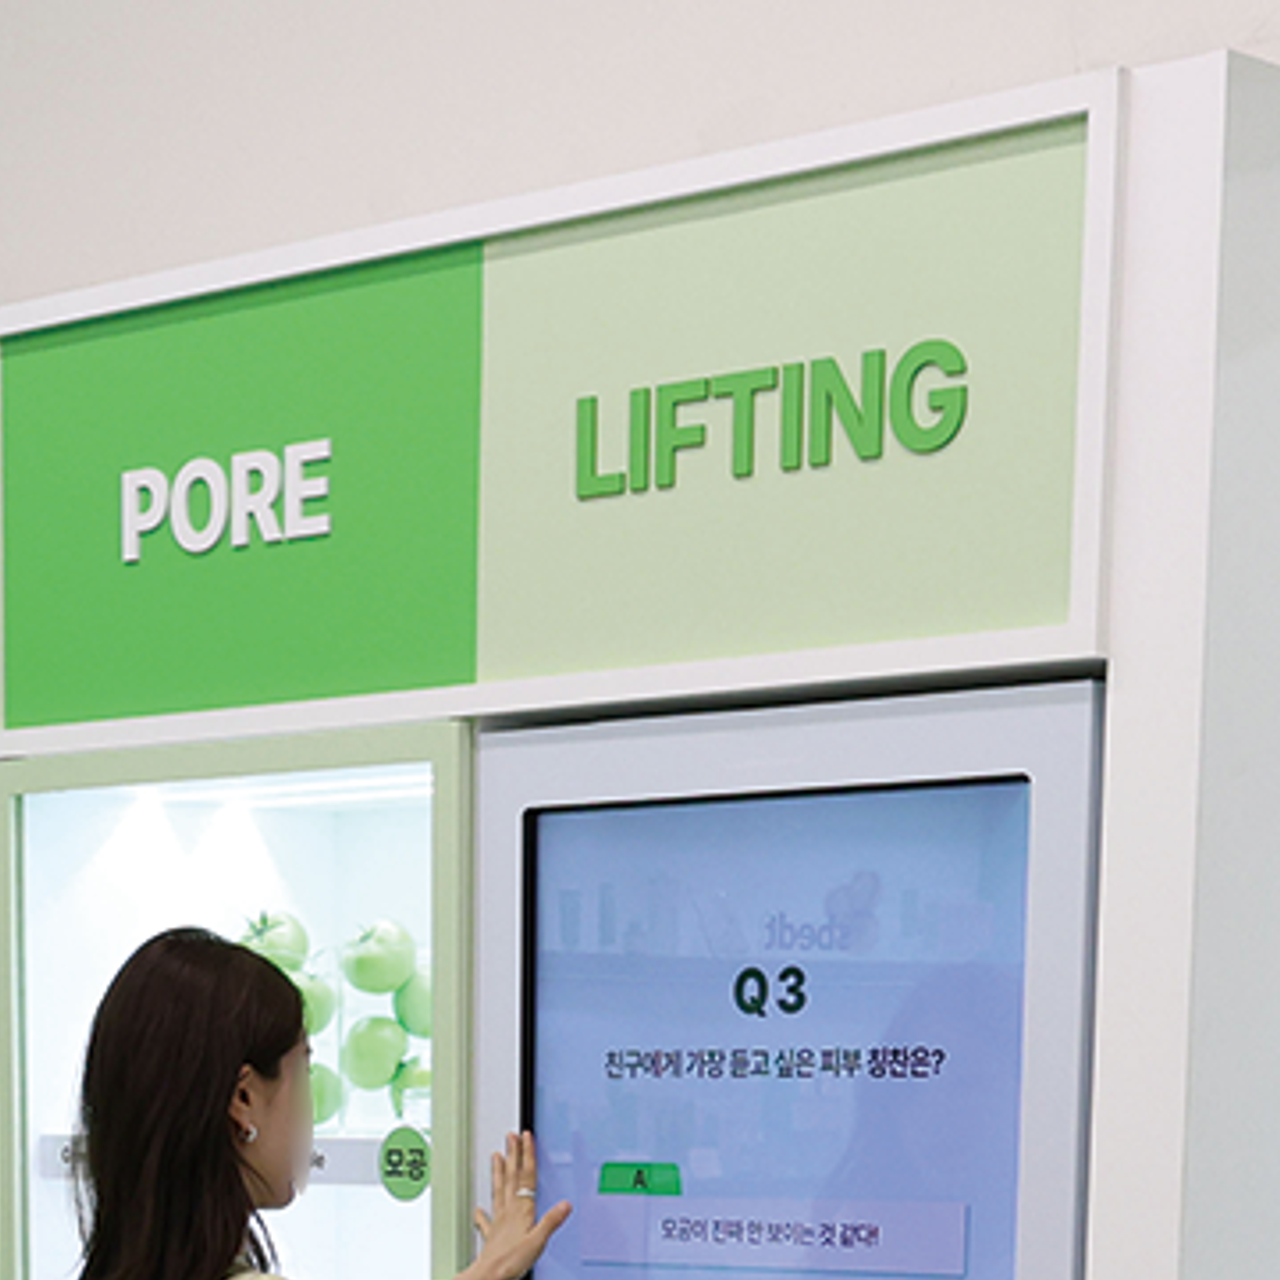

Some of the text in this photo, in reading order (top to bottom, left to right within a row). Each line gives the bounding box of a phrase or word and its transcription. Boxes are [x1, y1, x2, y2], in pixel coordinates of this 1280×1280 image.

[120, 437, 333, 564] PORE
[575, 339, 969, 501] LIFTING
[733, 965, 807, 1017] Q3
[604, 1045, 946, 1079] 친구에게 가장 듣고 싶은 피부 칭찬은?
[384, 1148, 427, 1181] 모공
[633, 1169, 648, 1189] A
[820, 1221, 837, 1247] 것
